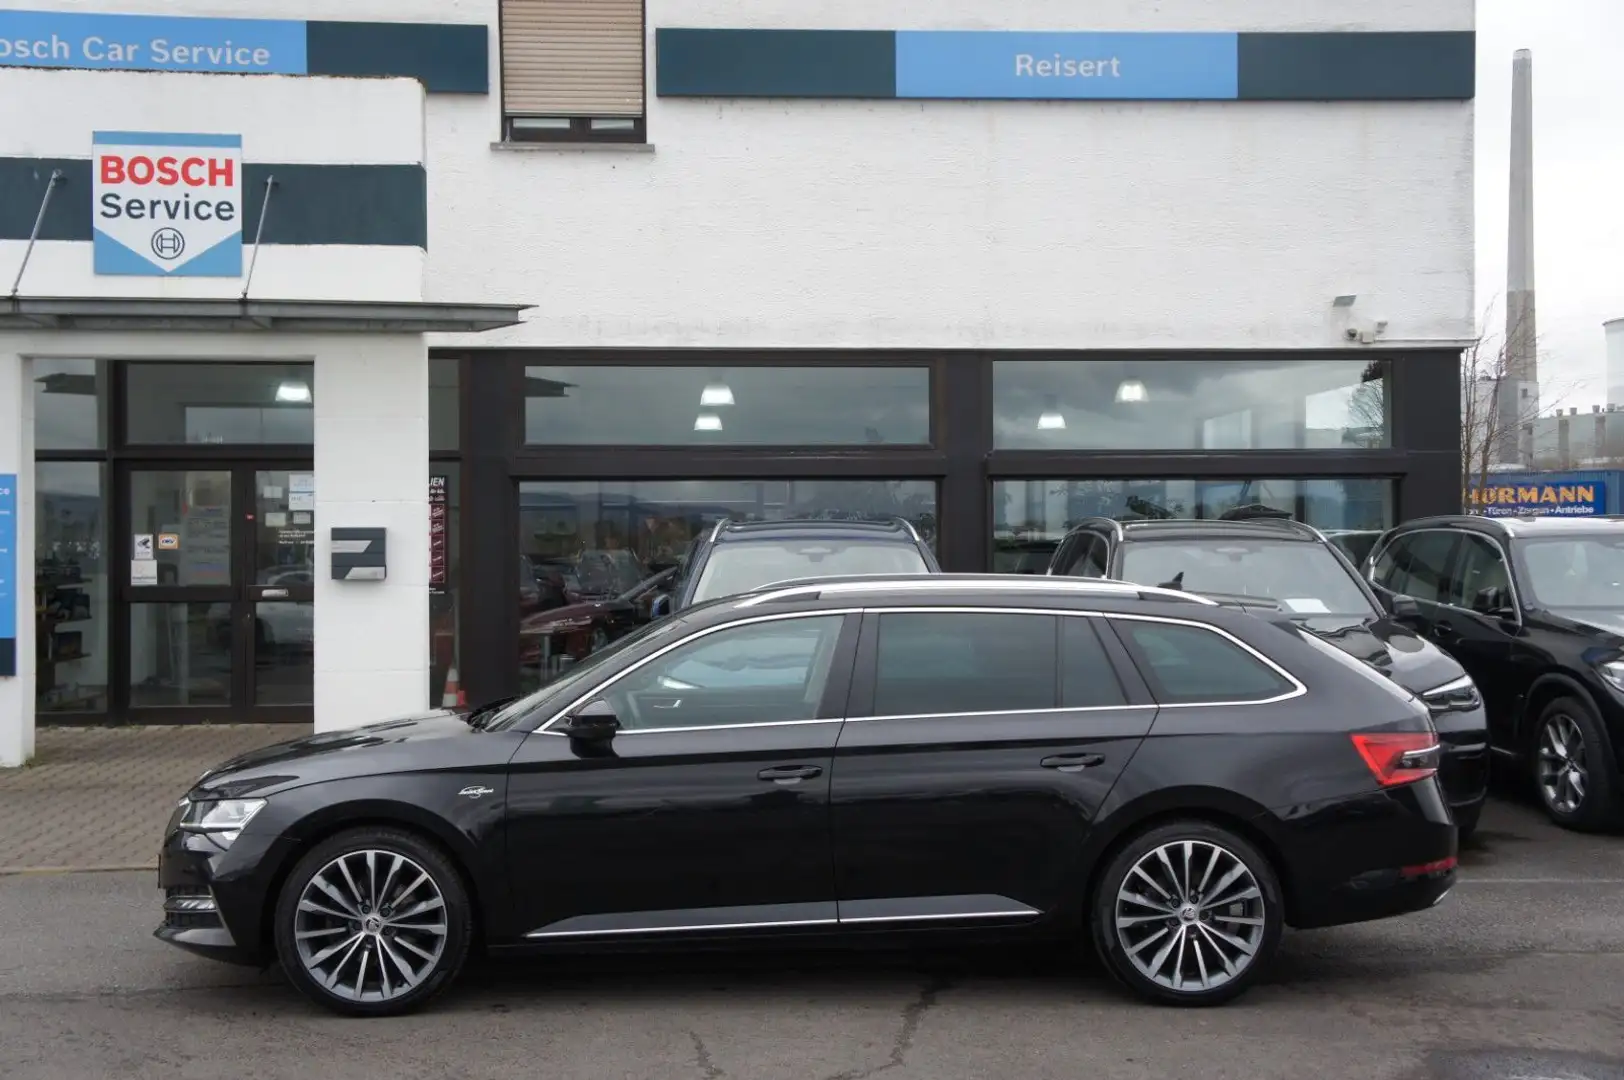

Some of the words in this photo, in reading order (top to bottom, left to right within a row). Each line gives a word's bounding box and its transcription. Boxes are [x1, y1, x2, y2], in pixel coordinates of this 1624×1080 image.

[82, 36, 139, 62] Car
[150, 39, 271, 65] Service
[1015, 53, 1121, 77] Reisert
[100, 155, 234, 187] BOSCH
[100, 192, 235, 221] Service
[1554, 505, 1594, 514] Antriebe
